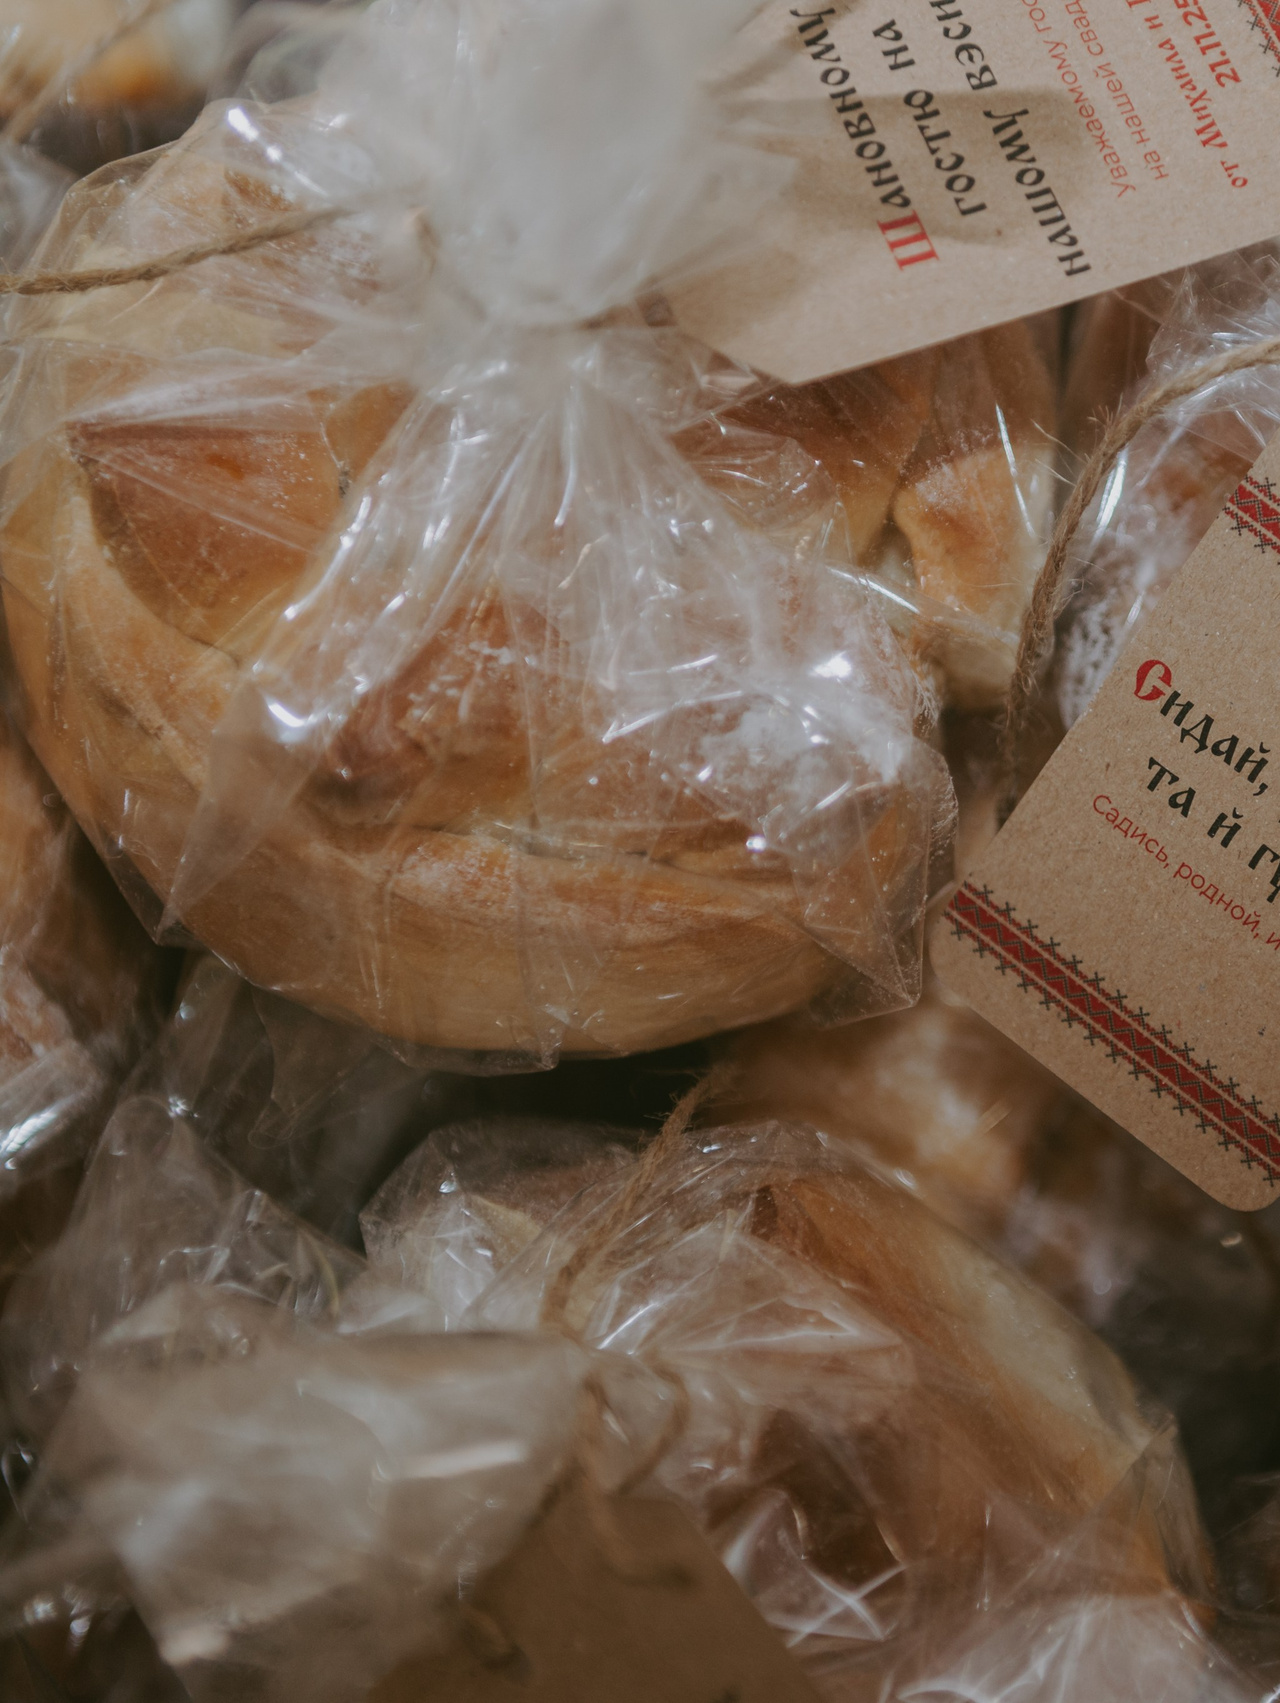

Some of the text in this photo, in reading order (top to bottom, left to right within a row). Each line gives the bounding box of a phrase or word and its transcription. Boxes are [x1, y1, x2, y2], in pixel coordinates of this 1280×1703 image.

[789, 7, 940, 271] Шановному
[872, 18, 988, 216] гостю на
[1043, 39, 1136, 198] Уважаемому
[1093, 62, 1151, 145] нашей
[1143, 150, 1169, 181] на
[1144, 14, 1248, 189] от Михаила и
[983, 108, 1092, 277] нашому
[1133, 659, 1271, 797] Сидай,
[1147, 756, 1197, 819] та
[1206, 806, 1244, 849] й
[1092, 794, 1170, 870] Садись,
[1172, 862, 1262, 939] родной,
